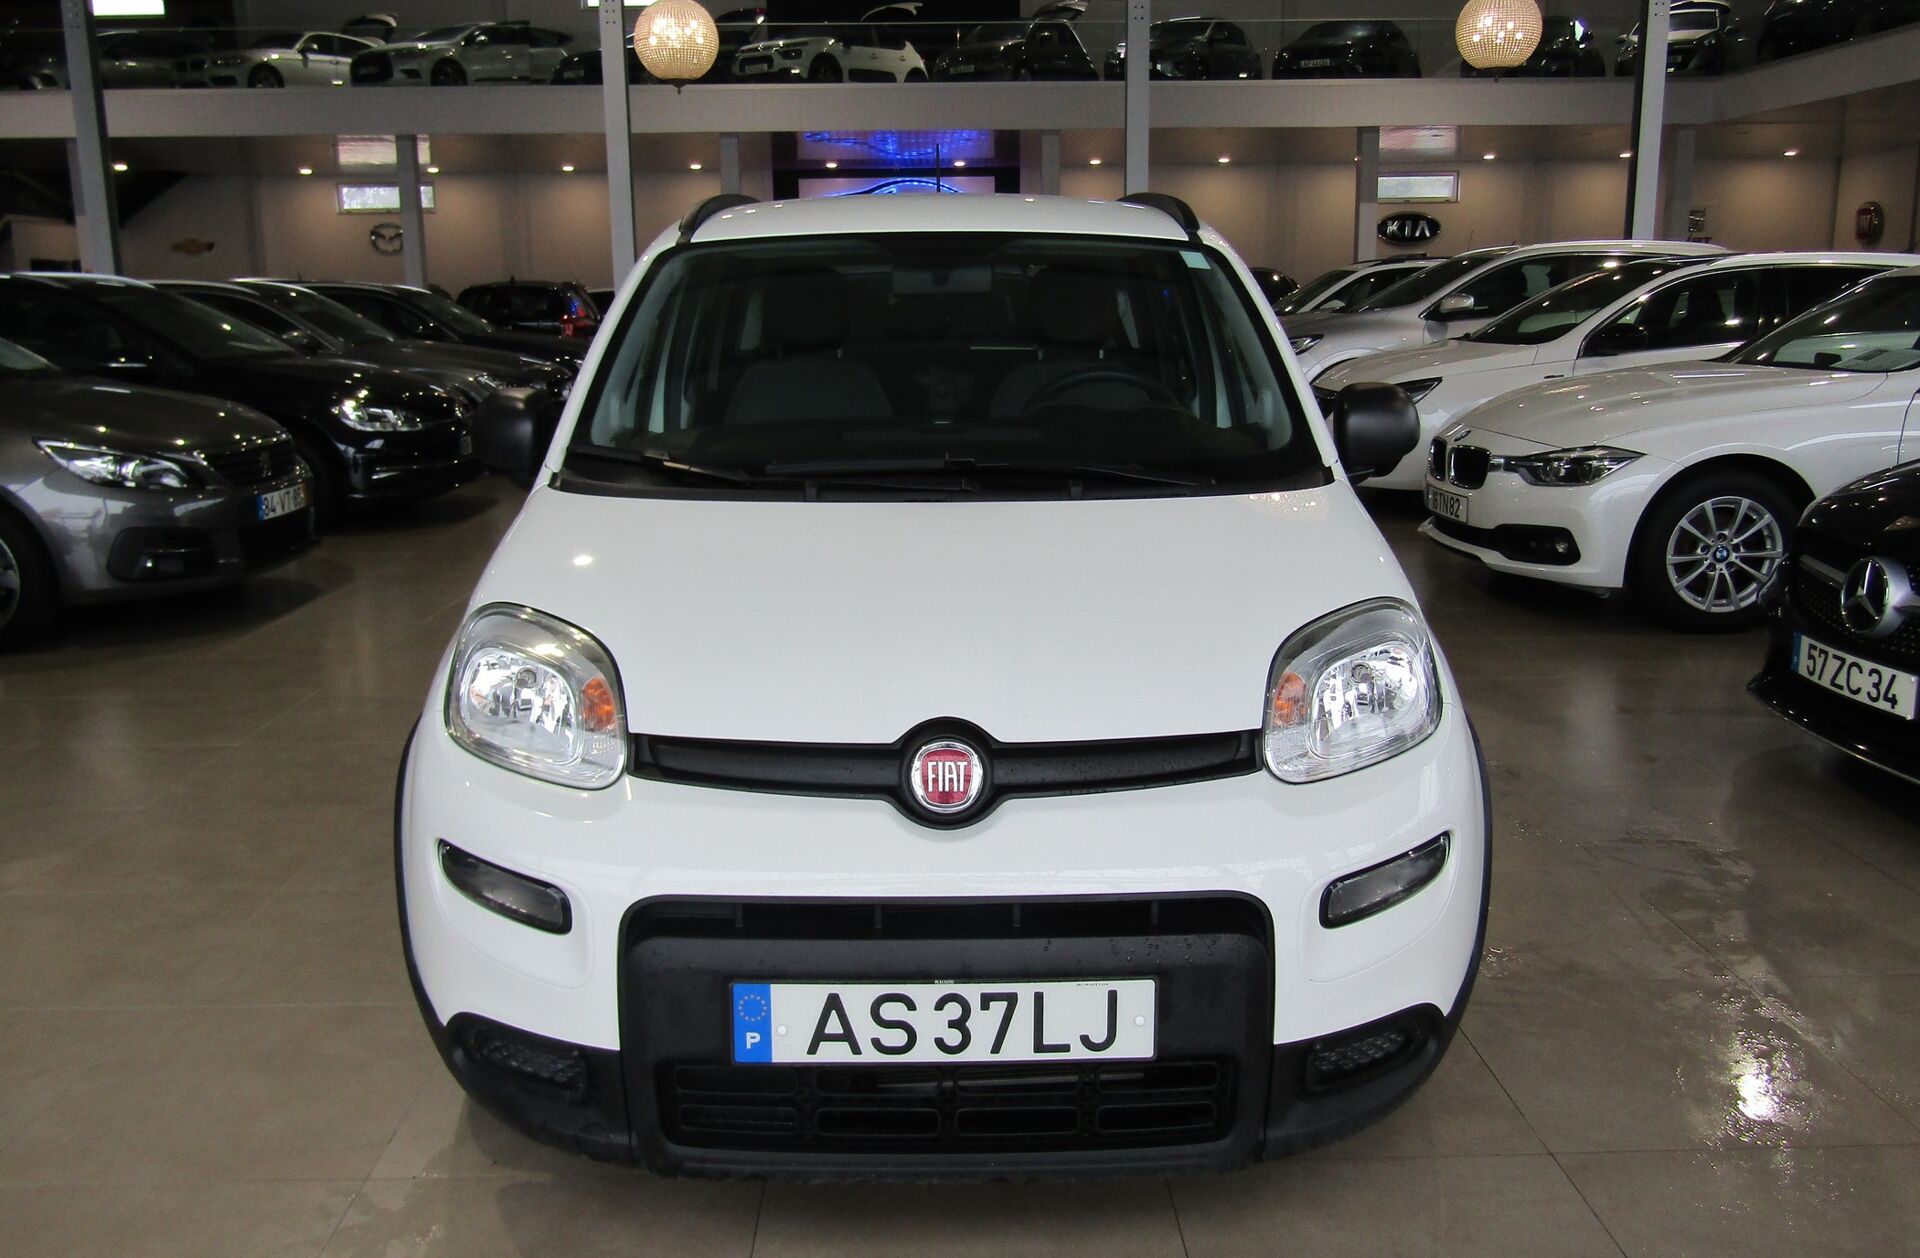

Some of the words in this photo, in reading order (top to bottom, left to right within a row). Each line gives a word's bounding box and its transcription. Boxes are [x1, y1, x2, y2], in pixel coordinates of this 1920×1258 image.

[1386, 220, 1430, 237] KIA
[1807, 643, 1898, 709] 57ZC34
[927, 761, 968, 792] FIAT
[806, 989, 1118, 1055] AS37LJ
[746, 1032, 760, 1049] P
